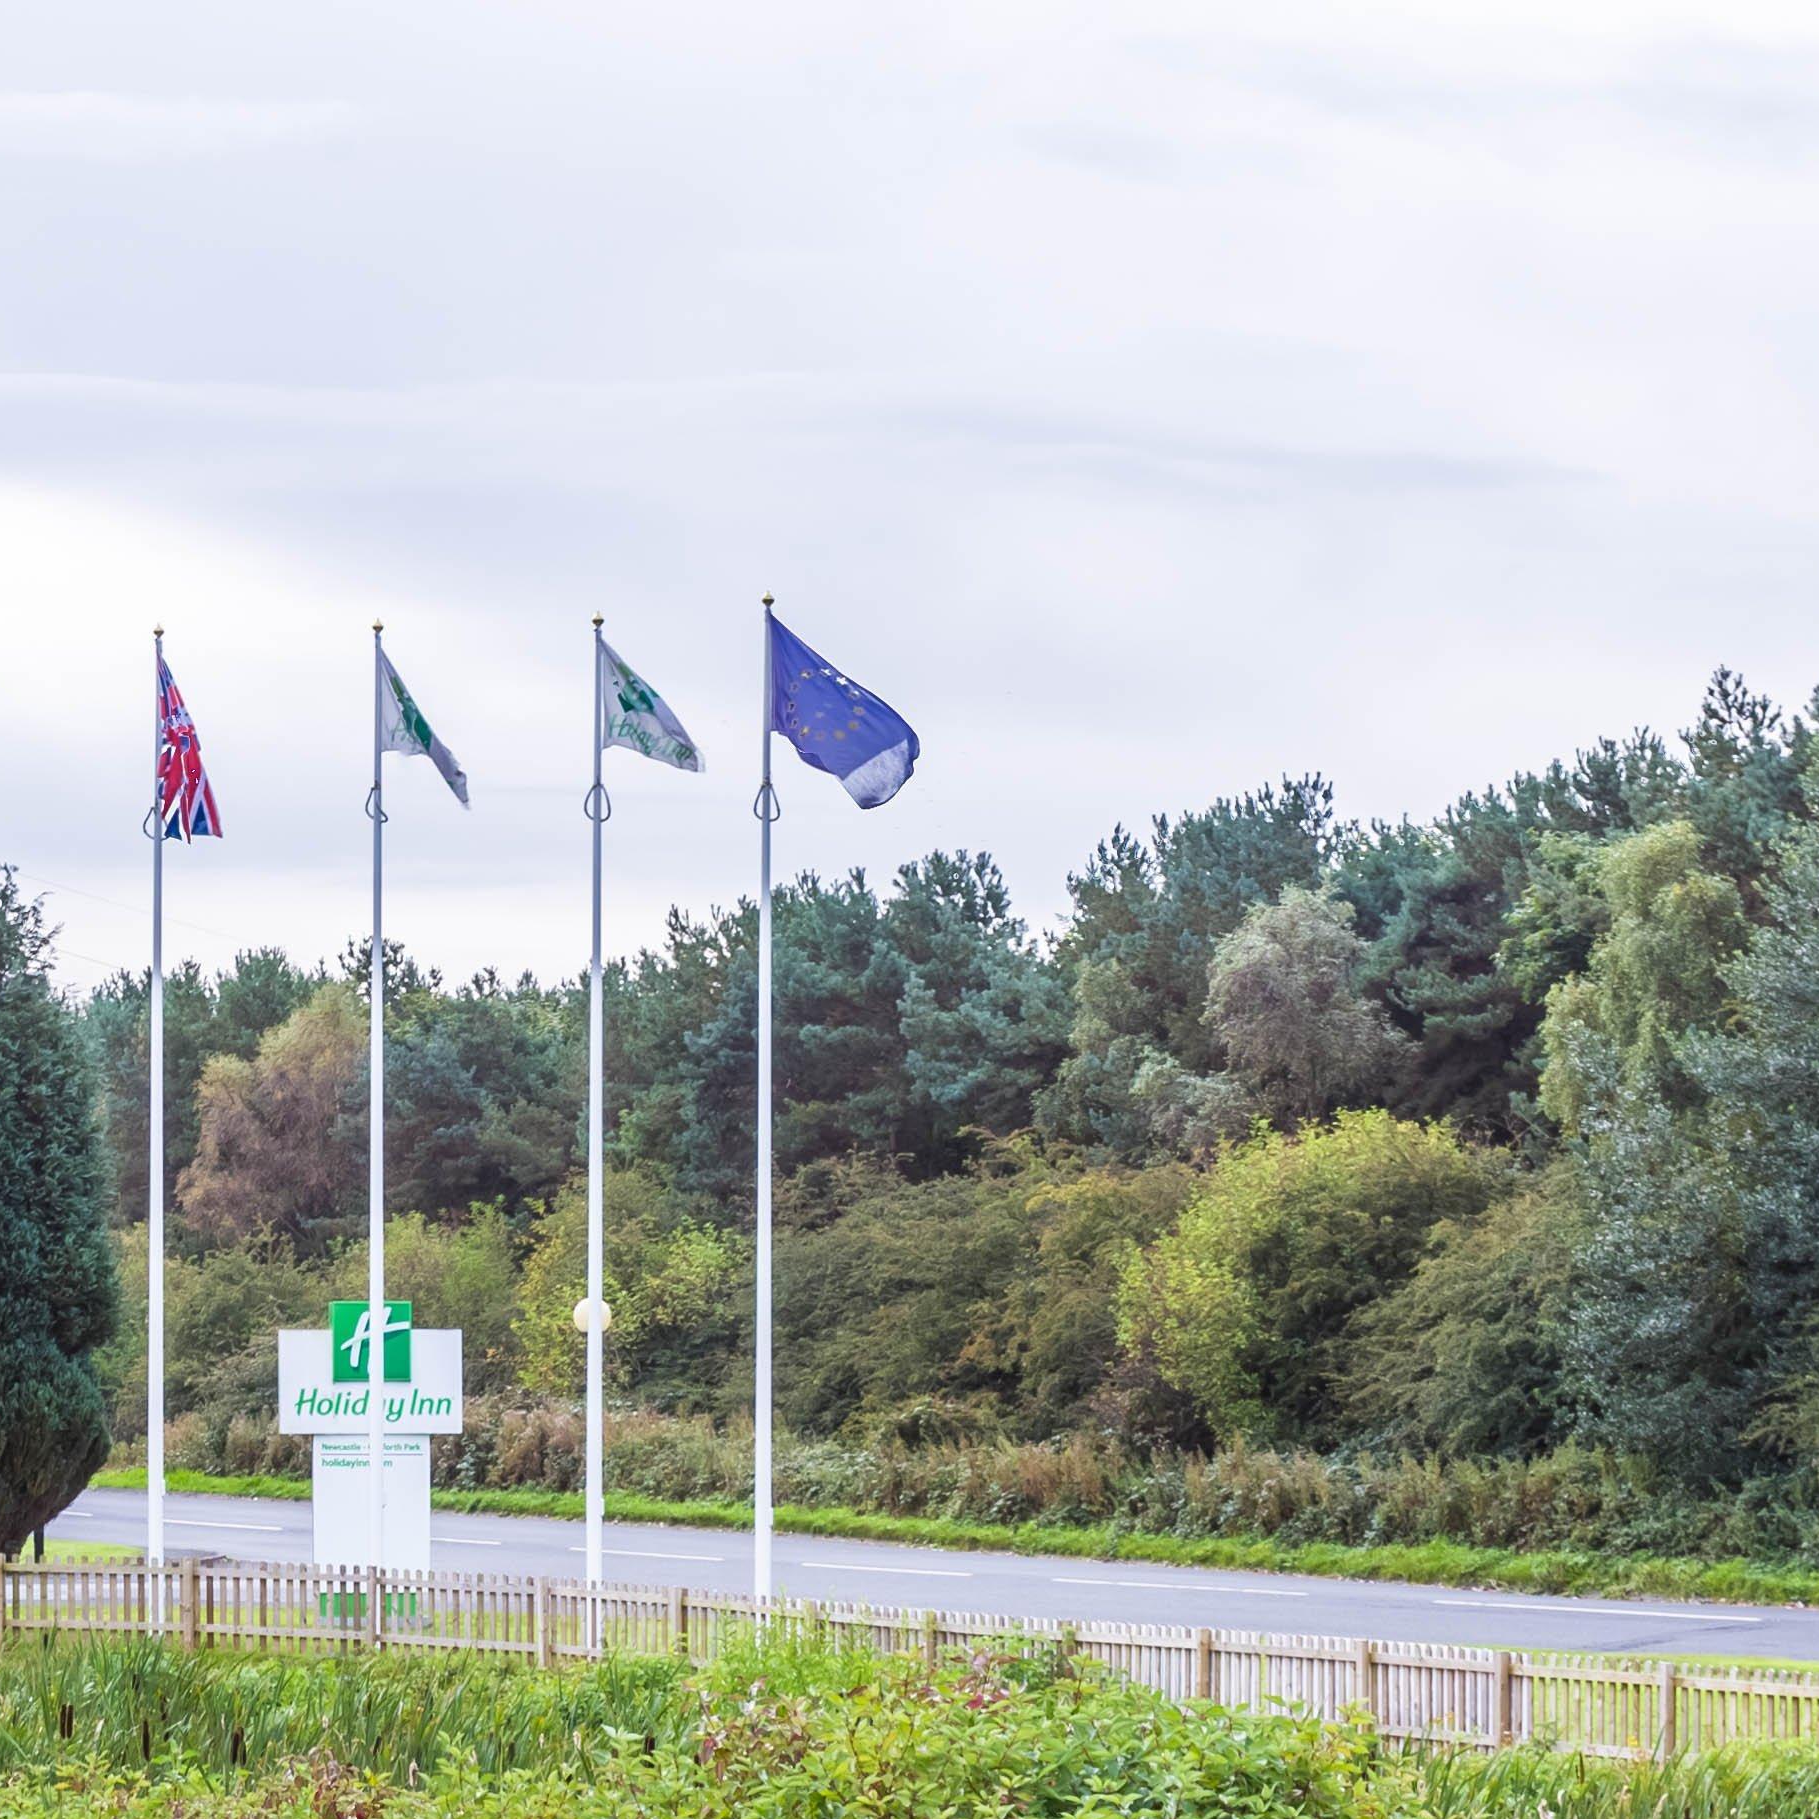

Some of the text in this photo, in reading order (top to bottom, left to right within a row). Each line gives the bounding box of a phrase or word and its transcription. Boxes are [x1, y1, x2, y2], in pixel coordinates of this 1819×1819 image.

[294, 1388, 452, 1422] Holidy Inn
[321, 1458, 393, 1468] holidayinnm
